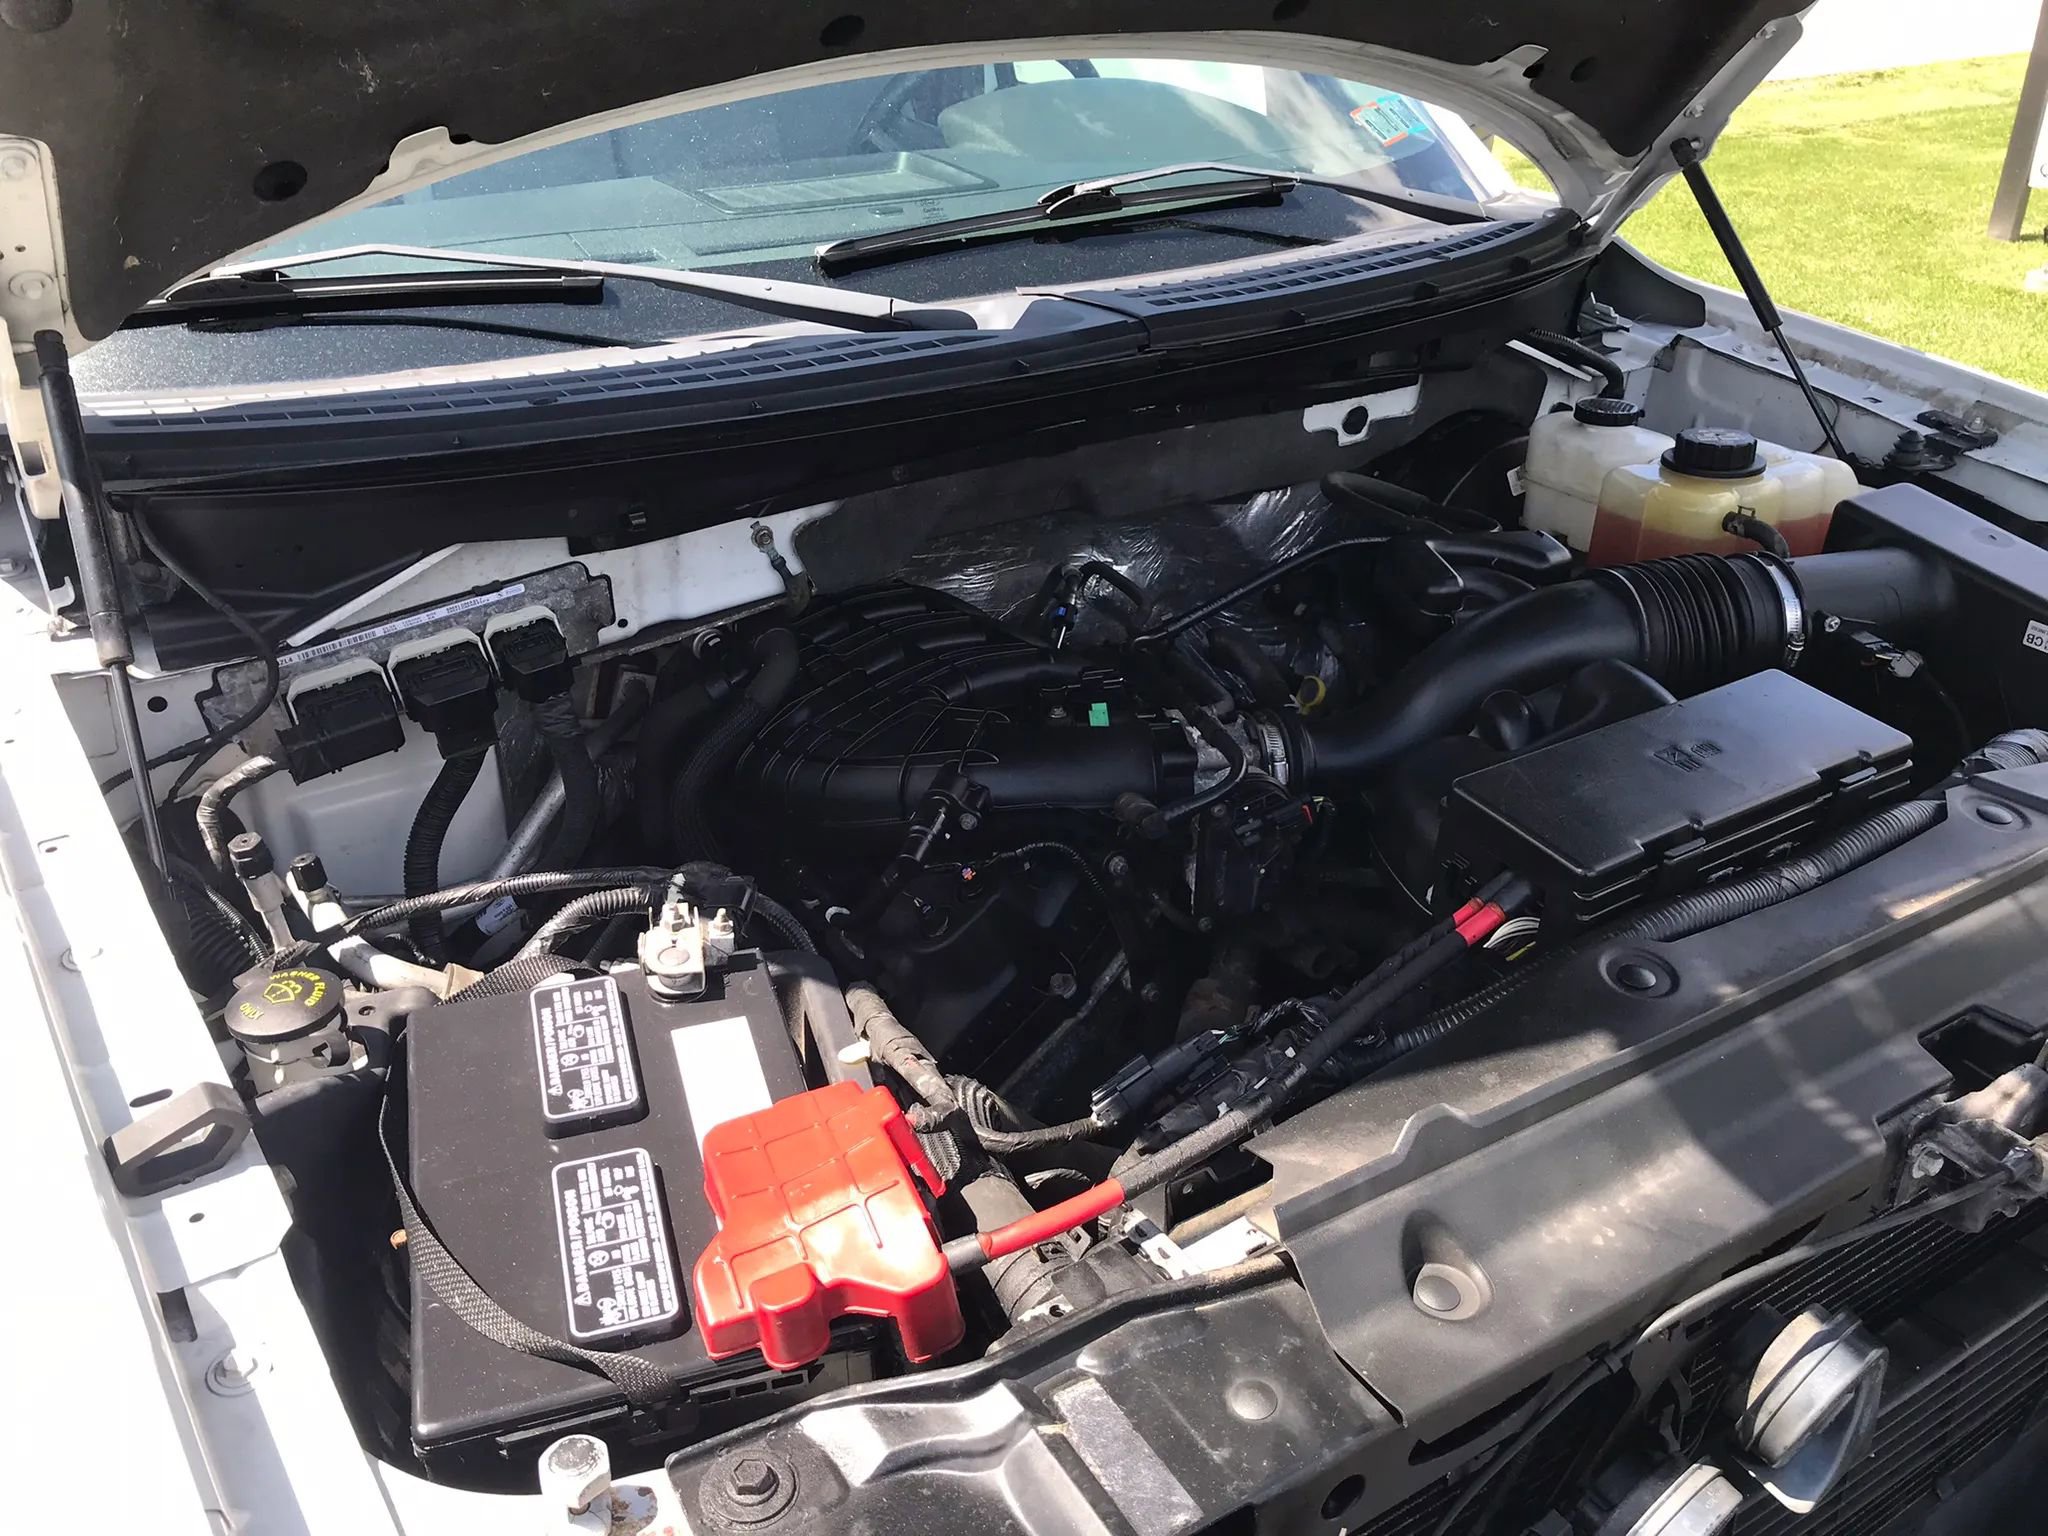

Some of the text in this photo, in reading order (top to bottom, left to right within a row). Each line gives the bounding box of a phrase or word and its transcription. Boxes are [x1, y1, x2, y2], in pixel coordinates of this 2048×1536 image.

[240, 970, 325, 1020] WASHER FLUID ONLY
